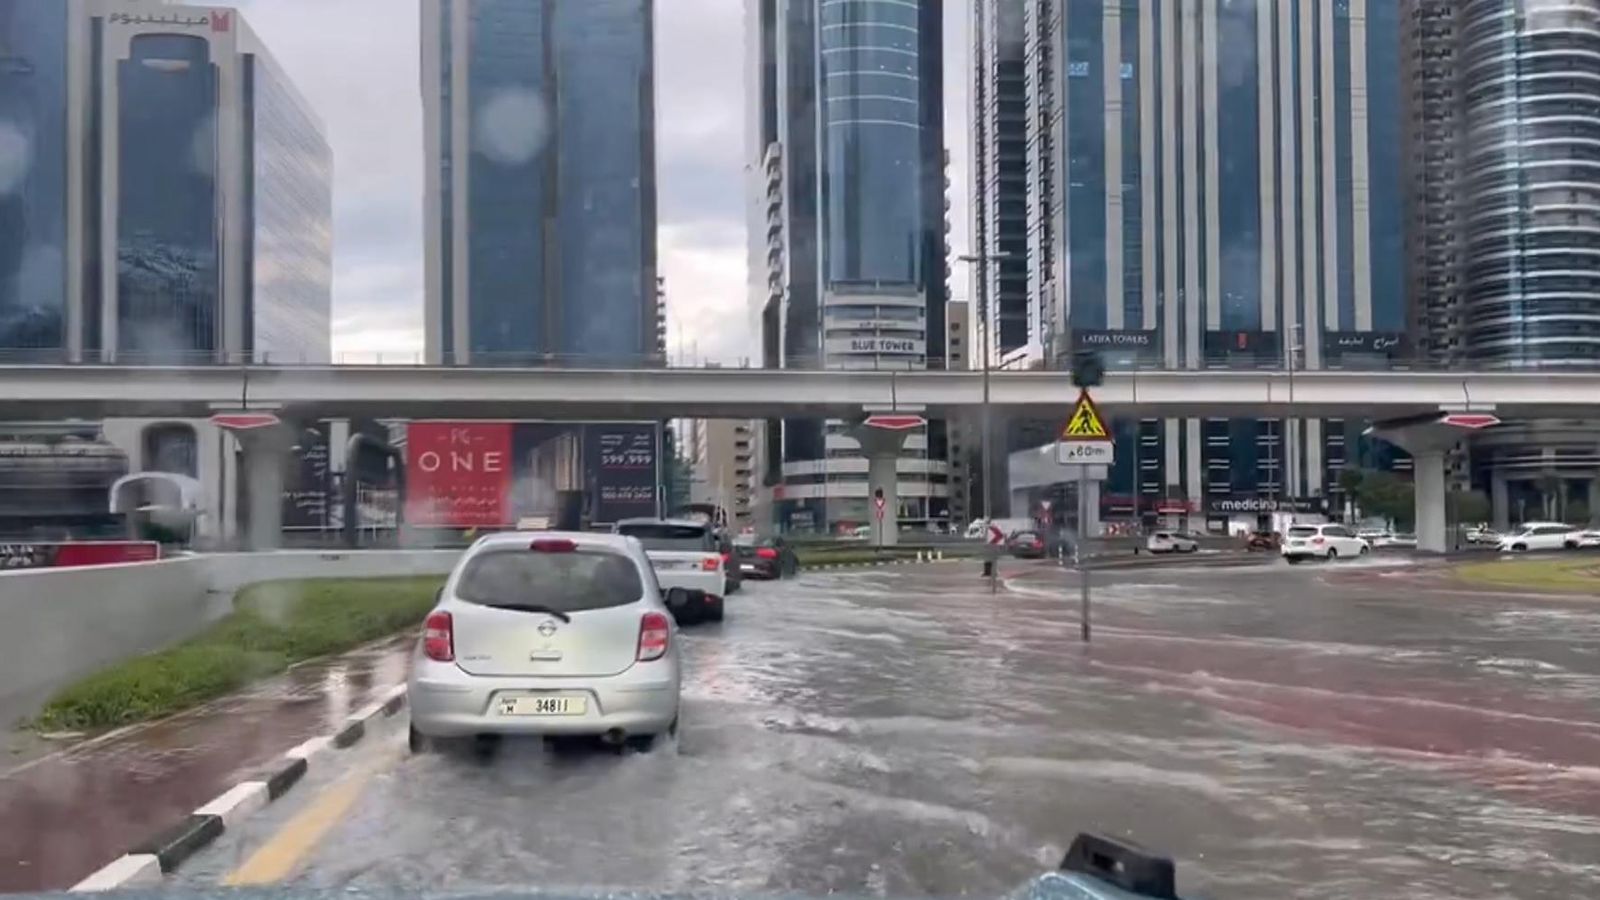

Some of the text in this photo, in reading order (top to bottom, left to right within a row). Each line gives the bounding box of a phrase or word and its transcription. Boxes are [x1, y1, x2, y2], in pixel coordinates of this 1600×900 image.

[851, 340, 915, 351] BLUE TOWER
[418, 451, 502, 473] ONE
[1221, 499, 1278, 511] medicina
[535, 698, 569, 713] 34811
